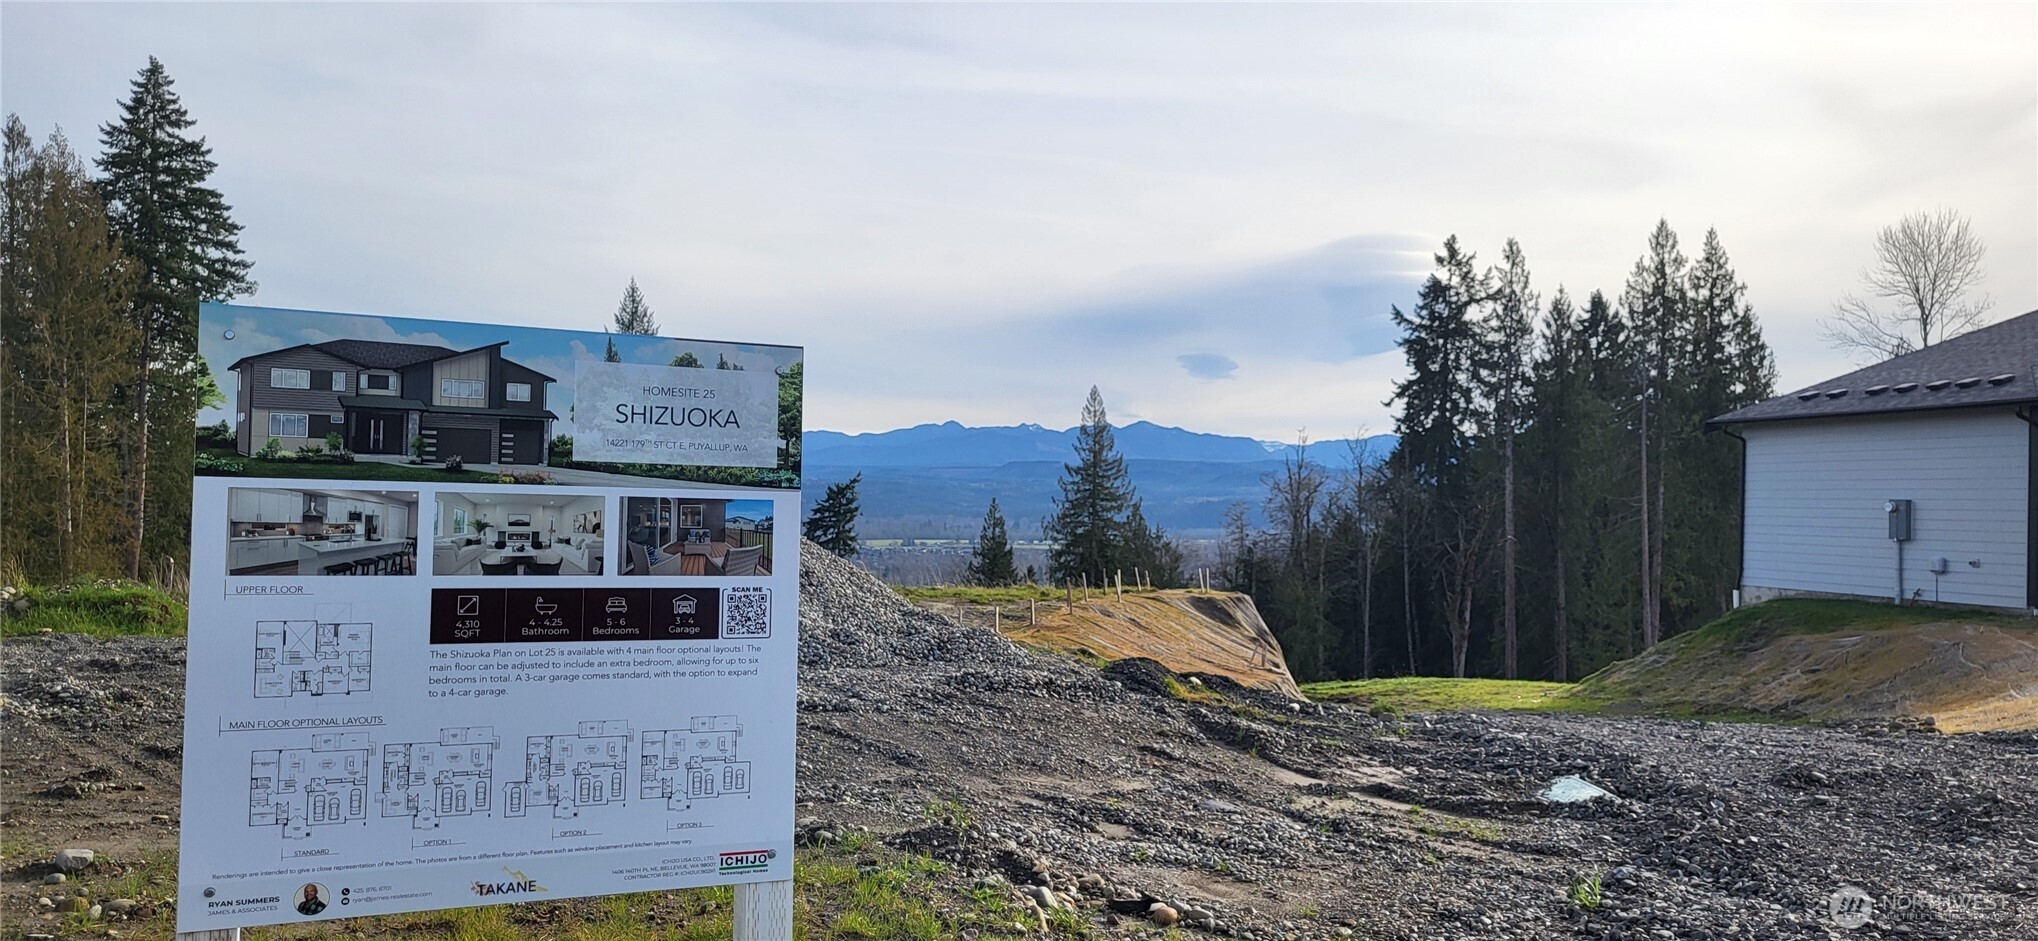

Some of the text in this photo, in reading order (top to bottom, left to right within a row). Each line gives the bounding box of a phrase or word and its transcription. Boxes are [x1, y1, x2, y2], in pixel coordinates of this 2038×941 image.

[643, 386, 716, 399] HOMESITE 25
[616, 403, 740, 428] SHIZUOKA
[606, 439, 628, 448] 14221
[654, 440, 665, 449] ST
[666, 441, 679, 450] CT
[689, 442, 732, 453] PUYALLUP,
[734, 443, 748, 452] WA
[235, 585, 303, 594] UPPER FLOOR
[455, 620, 480, 629] 4,310
[529, 618, 535, 626] 4
[544, 618, 563, 626] 4.25
[619, 617, 626, 625] 6
[675, 617, 681, 625] 3
[454, 629, 481, 638] SQFT
[521, 627, 569, 635] Bathroom
[592, 626, 640, 635] Bedrooms
[668, 625, 700, 634] Garage
[430, 650, 447, 659] The
[450, 649, 490, 658] Shizuoka
[493, 649, 512, 658] Plan
[529, 648, 543, 657] Lot
[545, 648, 556, 656] 25
[558, 648, 565, 656] is
[567, 647, 604, 656] available
[607, 647, 624, 655] with
[634, 646, 654, 654] main
[656, 646, 675, 654] floor
[677, 645, 711, 655] optional
[713, 644, 744, 655] layouts!
[746, 644, 761, 652] The
[429, 663, 452, 672] main
[454, 662, 477, 671] floor
[478, 663, 494, 671] can
[497, 662, 509, 670] be
[511, 661, 550, 671] adjusted
[552, 661, 561, 669] to
[563, 659, 595, 668] include
[610, 659, 631, 667] extra
[633, 658, 674, 668] bedroom,
[676, 657, 711, 667] allowing
[712, 657, 723, 665] for
[725, 658, 736, 666] up
[738, 657, 747, 665] to
[748, 656, 759, 664] six
[428, 667, 758, 685] bedrooms in total. A 3-car garage comes standard, with the option to expand
[448, 688, 473, 697] 4-car
[474, 688, 509, 698] garage.
[229, 716, 383, 730] MAIN FLOOR OPTIONAL LAYOUTS
[294, 848, 329, 857] STANDARD
[212, 871, 248, 880] Renderings
[260, 868, 288, 876] intended
[297, 867, 310, 875] give
[333, 862, 376, 871] representation
[427, 857, 447, 865] photos
[478, 852, 501, 860] different
[515, 850, 529, 858] plan.
[530, 848, 553, 856] Features
[574, 845, 595, 853] window
[595, 843, 623, 852] placement
[634, 840, 653, 848] kitchen
[654, 838, 670, 847] layout
[720, 854, 767, 867] ICHIJO
[624, 872, 661, 880] CONTRACTOR
[478, 880, 537, 896] TAKANE
[208, 896, 280, 909] RYAN SUMMERS
[207, 908, 230, 916] JAMES
[237, 905, 278, 914] ASSOCIATES
